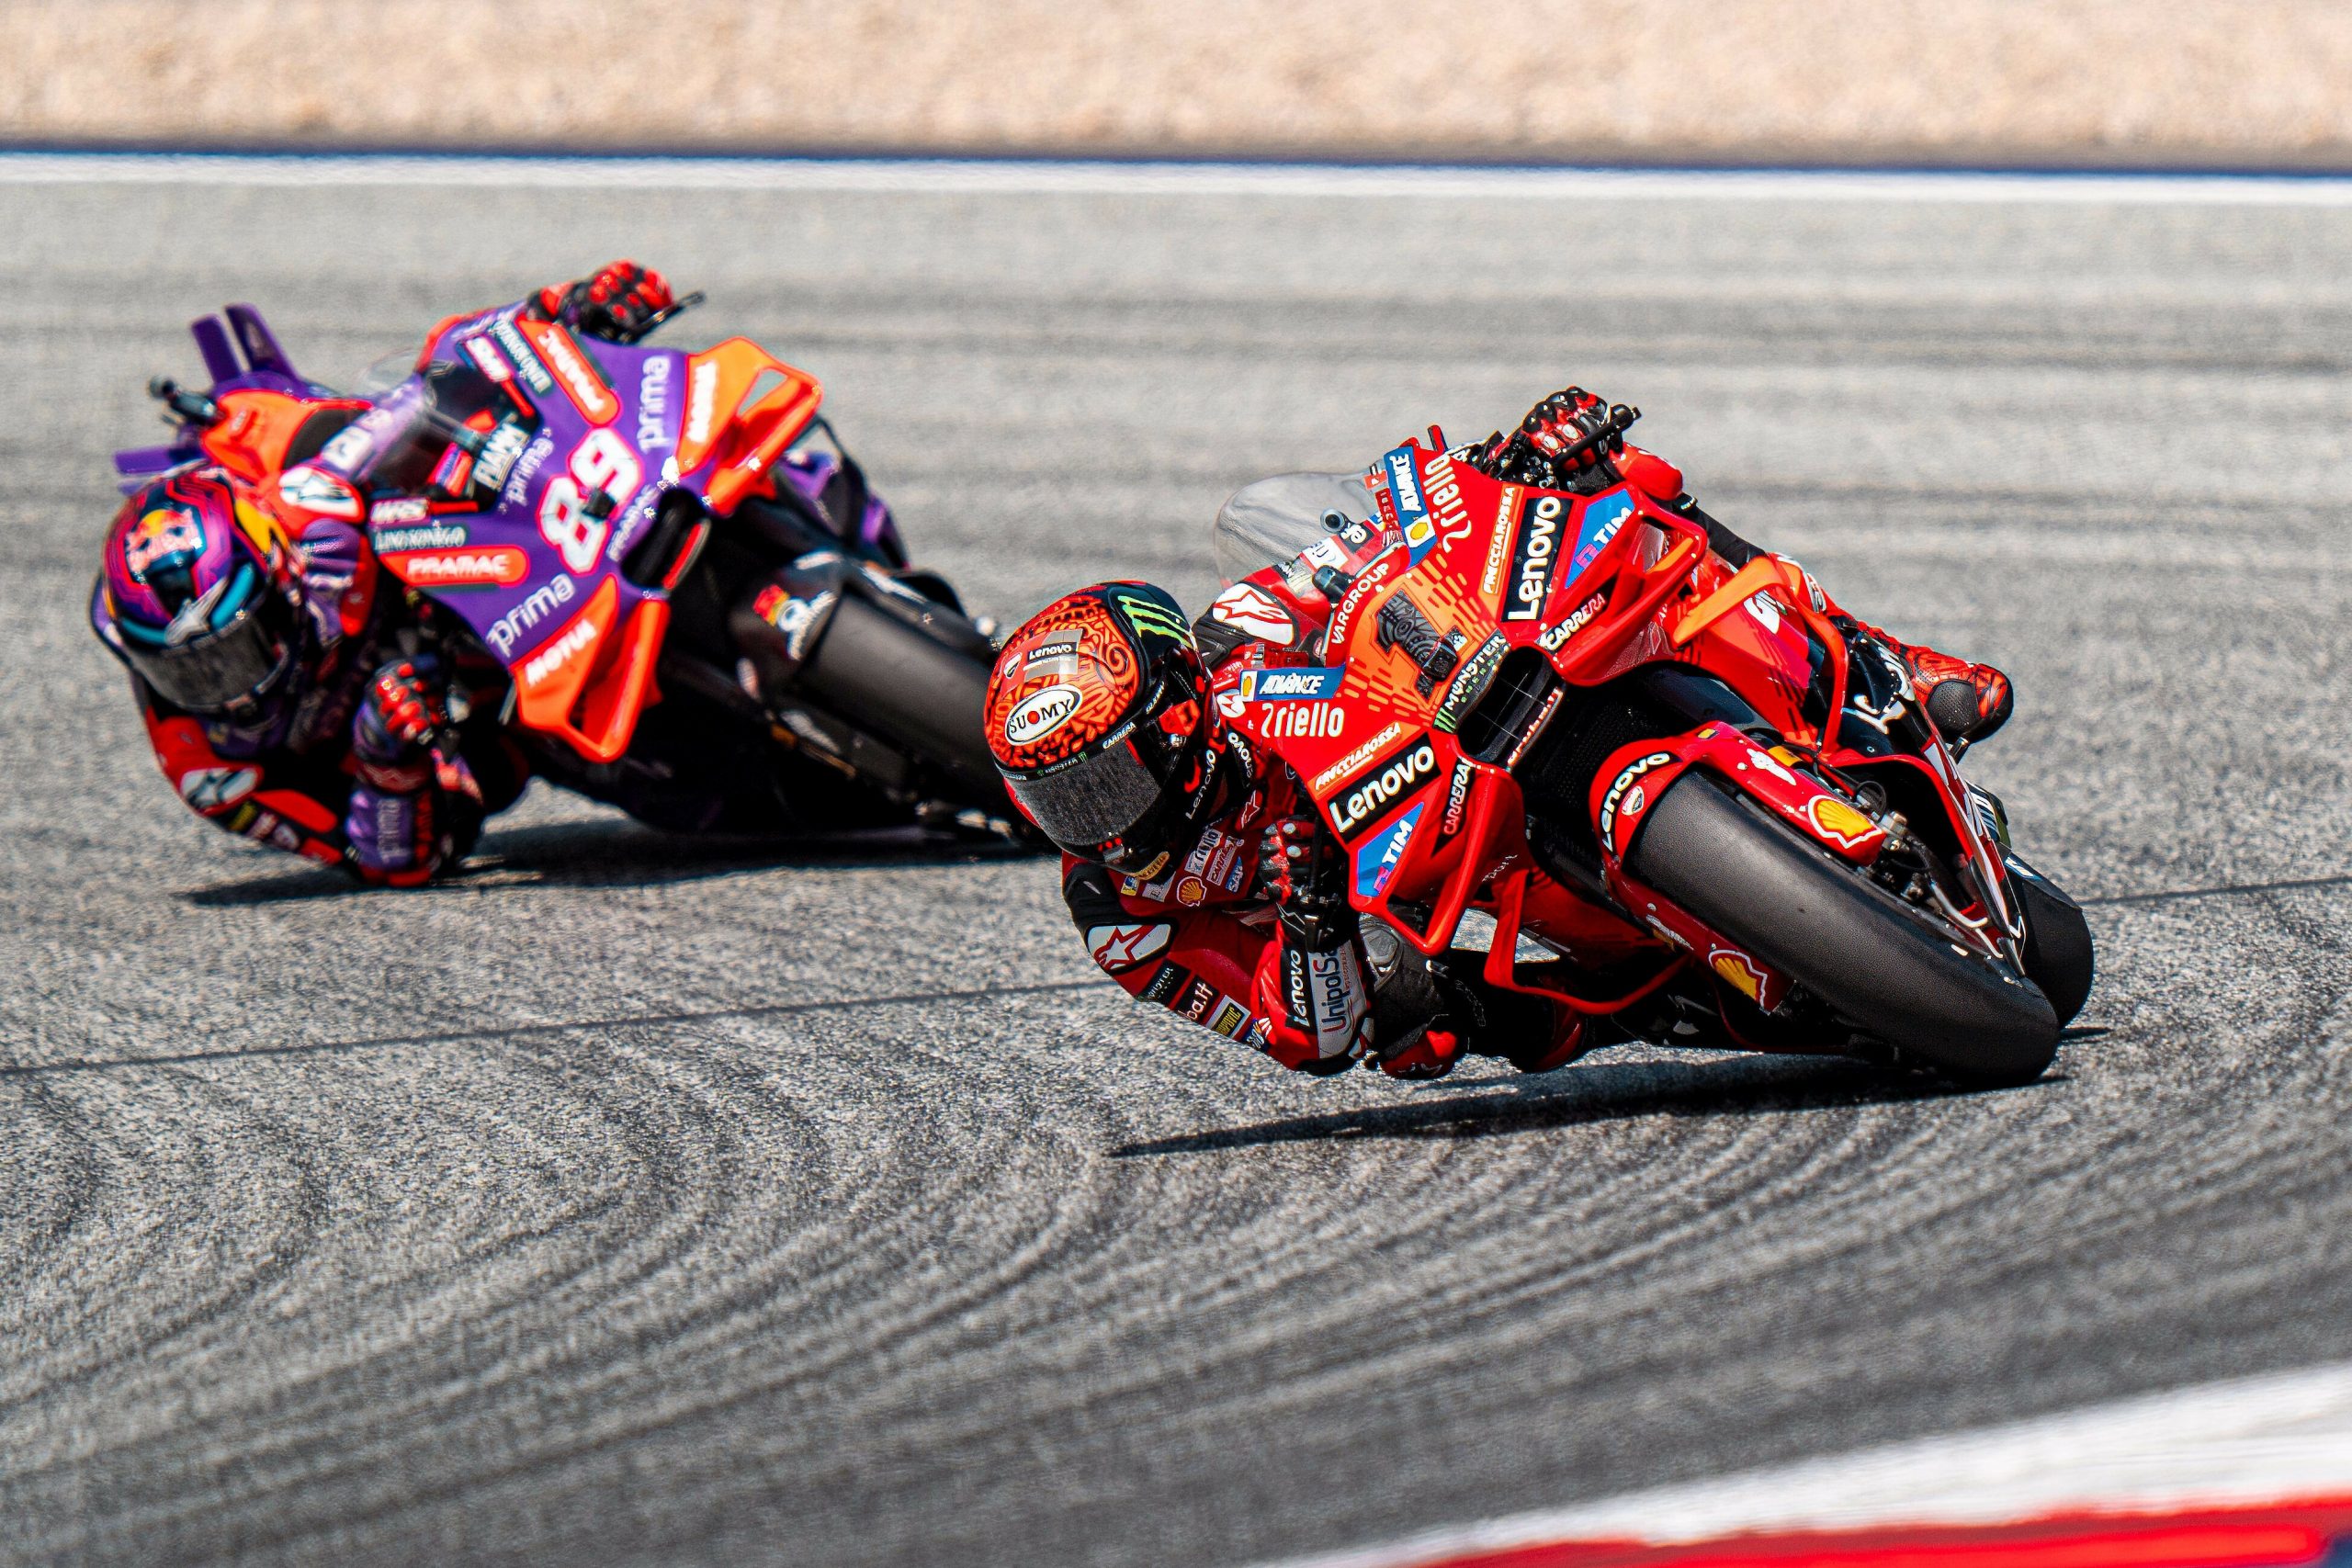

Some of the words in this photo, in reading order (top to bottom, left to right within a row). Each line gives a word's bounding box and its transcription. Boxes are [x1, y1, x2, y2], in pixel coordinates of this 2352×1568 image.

[637, 355, 672, 455] prima
[505, 437, 555, 506] prima
[539, 427, 640, 573] 89
[1508, 496, 1562, 621] Lenovo
[1593, 506, 1632, 544] TIM
[485, 573, 576, 659] prima
[1541, 592, 1607, 650] CARRERA
[525, 618, 597, 687] MOTUL
[1028, 644, 1073, 660] Lenovo
[1259, 673, 1325, 695] ADVANCE
[1009, 698, 1072, 735] SUOMY
[1185, 749, 1216, 820] Lenovo
[1329, 745, 1435, 833] Lenovo
[1443, 761, 1471, 835] CARRERA
[1600, 752, 1670, 852] Lenovo
[1381, 818, 1414, 864] TIM
[1290, 949, 1311, 1028] Lenovo
